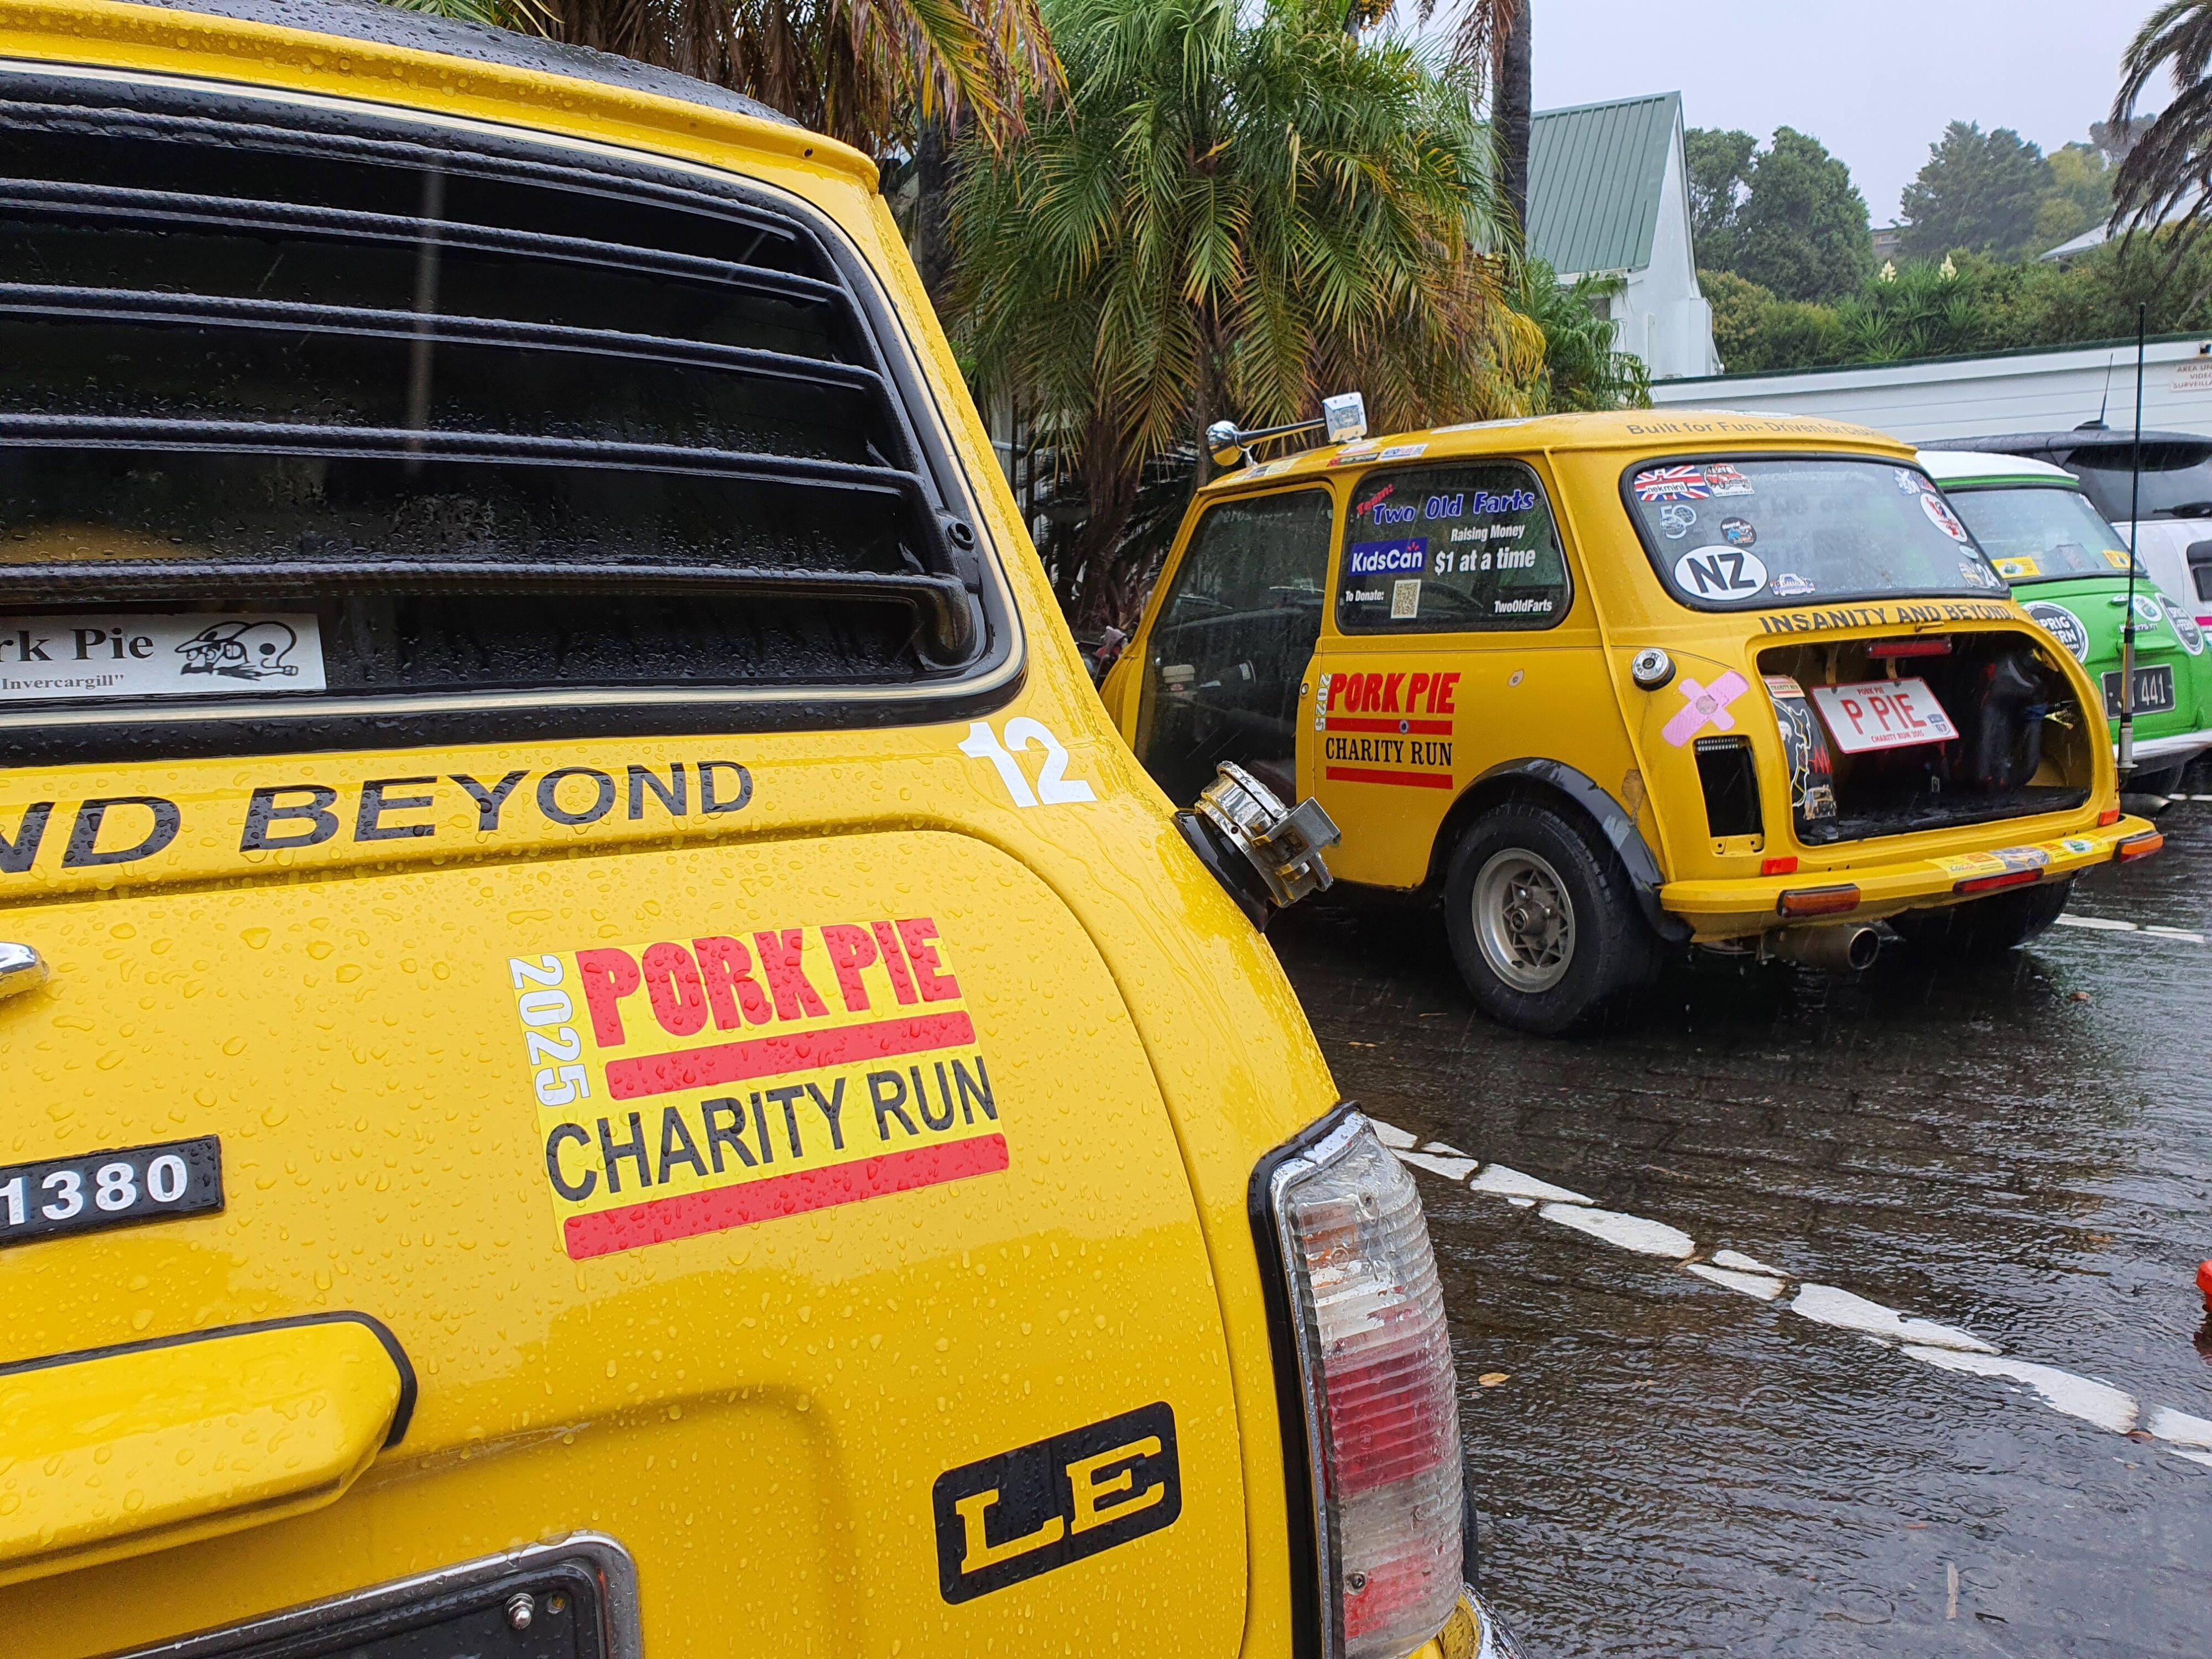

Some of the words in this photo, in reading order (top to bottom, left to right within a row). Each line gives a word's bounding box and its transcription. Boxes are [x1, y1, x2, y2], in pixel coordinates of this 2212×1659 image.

[1626, 422, 1682, 435] Built
[1683, 422, 1713, 432] for
[1764, 422, 1822, 433] Driven
[1357, 483, 1394, 517] Team:
[1373, 503, 1416, 525] Two
[1426, 494, 1464, 520] Old
[1473, 489, 1535, 515] Farts
[1451, 525, 1489, 542] Raising
[1491, 524, 1525, 540] Money
[1352, 549, 1422, 572] KidsCan
[1434, 551, 1453, 576] $1
[1459, 550, 1477, 572] at
[1480, 552, 1491, 570] a
[1497, 548, 1536, 570] time
[1687, 552, 1757, 594] NZ
[1345, 590, 1354, 602] To
[1355, 588, 1384, 602] Donate:
[1494, 599, 1552, 613] TwoOldFarts
[1759, 608, 1886, 633] INSANITY
[1897, 606, 1941, 624] AND
[2035, 616, 2070, 630] PRIG
[70, 627, 154, 661] Pie
[1315, 672, 1333, 732] 2025
[1327, 672, 1406, 713] PORK
[1405, 672, 1461, 714] PIE
[2141, 672, 2166, 707] 441
[1840, 698, 1864, 735] P
[1868, 693, 1927, 731] PIE
[1326, 737, 1404, 763] CHARITY
[1410, 741, 1453, 766] RUN
[1871, 733, 1897, 743] CHARITY
[957, 716, 1098, 808] 12
[239, 760, 753, 852] BEYOND
[576, 928, 829, 1048] PORK
[821, 917, 963, 1011] PIE
[507, 954, 591, 1107] 2025
[546, 1077, 847, 1202] CHARITY
[866, 1055, 999, 1141] RUN
[0, 1155, 188, 1225] 1380
[954, 1435, 1165, 1575] LE
